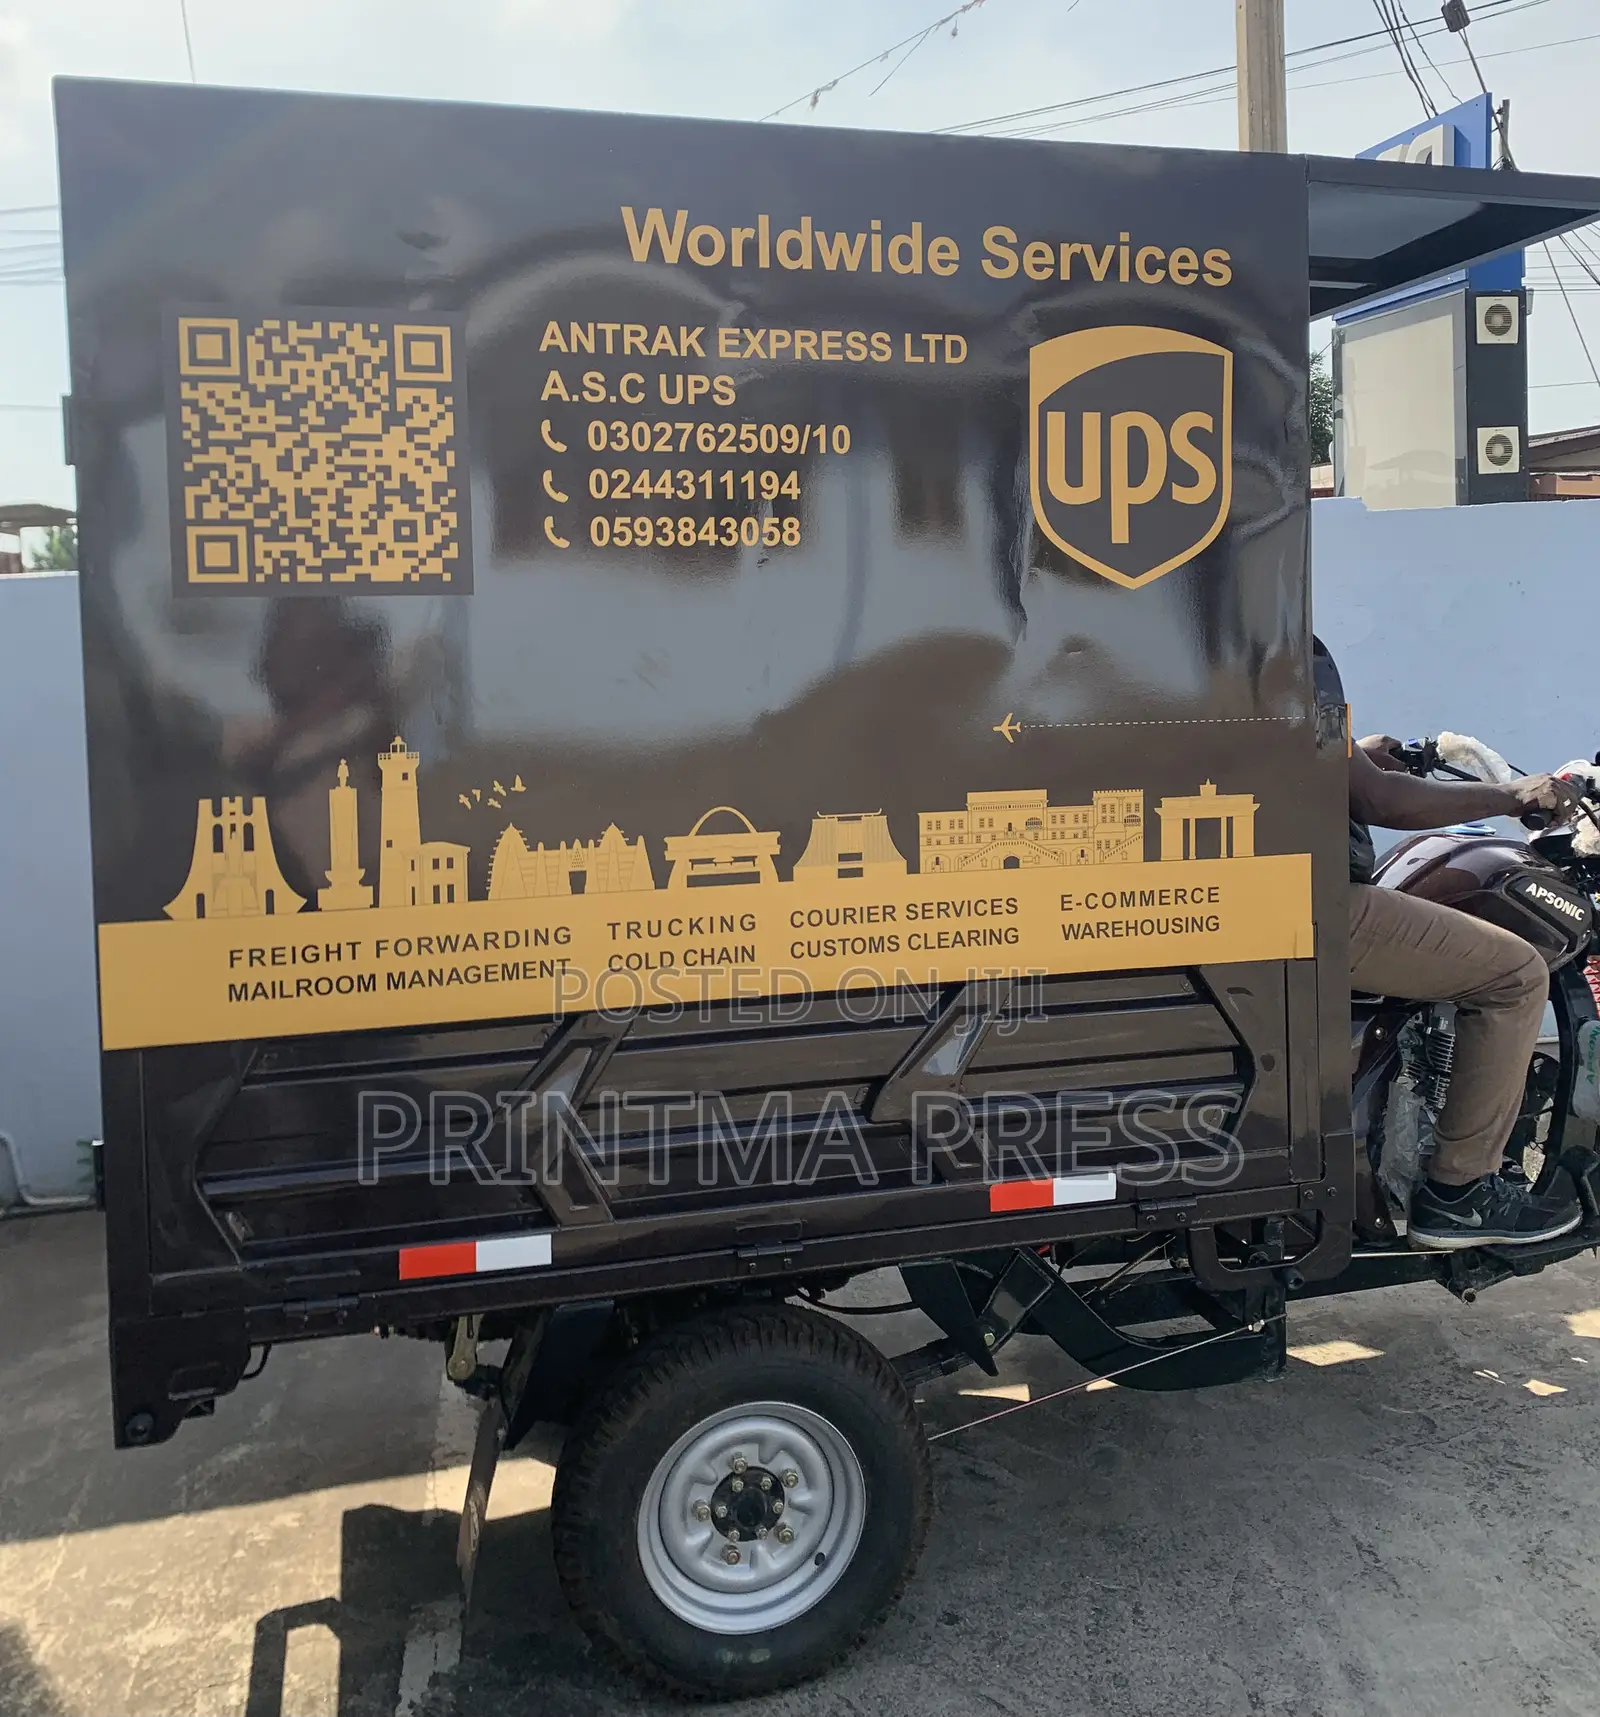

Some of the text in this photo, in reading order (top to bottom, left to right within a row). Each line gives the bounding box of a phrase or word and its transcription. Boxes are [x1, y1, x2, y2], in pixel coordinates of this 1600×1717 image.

[622, 206, 1233, 286] Worldwide Services
[540, 320, 968, 364] ANTRAK EXPRESS LTD
[541, 371, 736, 406] A.S.C UPS
[587, 420, 851, 454] 0302762509/10
[589, 468, 801, 500] 0244311194
[1046, 410, 1217, 545] ups
[589, 516, 801, 547] 0593843058
[789, 897, 1019, 929] COURIER SERVICES
[1060, 887, 1220, 911] E-COMMERCE
[1525, 882, 1585, 921] APSONIC
[607, 913, 757, 940] TRUCKING
[1061, 915, 1220, 941] WAREHOUSING
[229, 926, 572, 968] FREIGHT FORWARDING
[607, 945, 756, 972] COLD CHAIN
[789, 927, 1020, 960] CUSTOMS CLEARING
[228, 958, 572, 1003] MAILROOM MANAGEMENT
